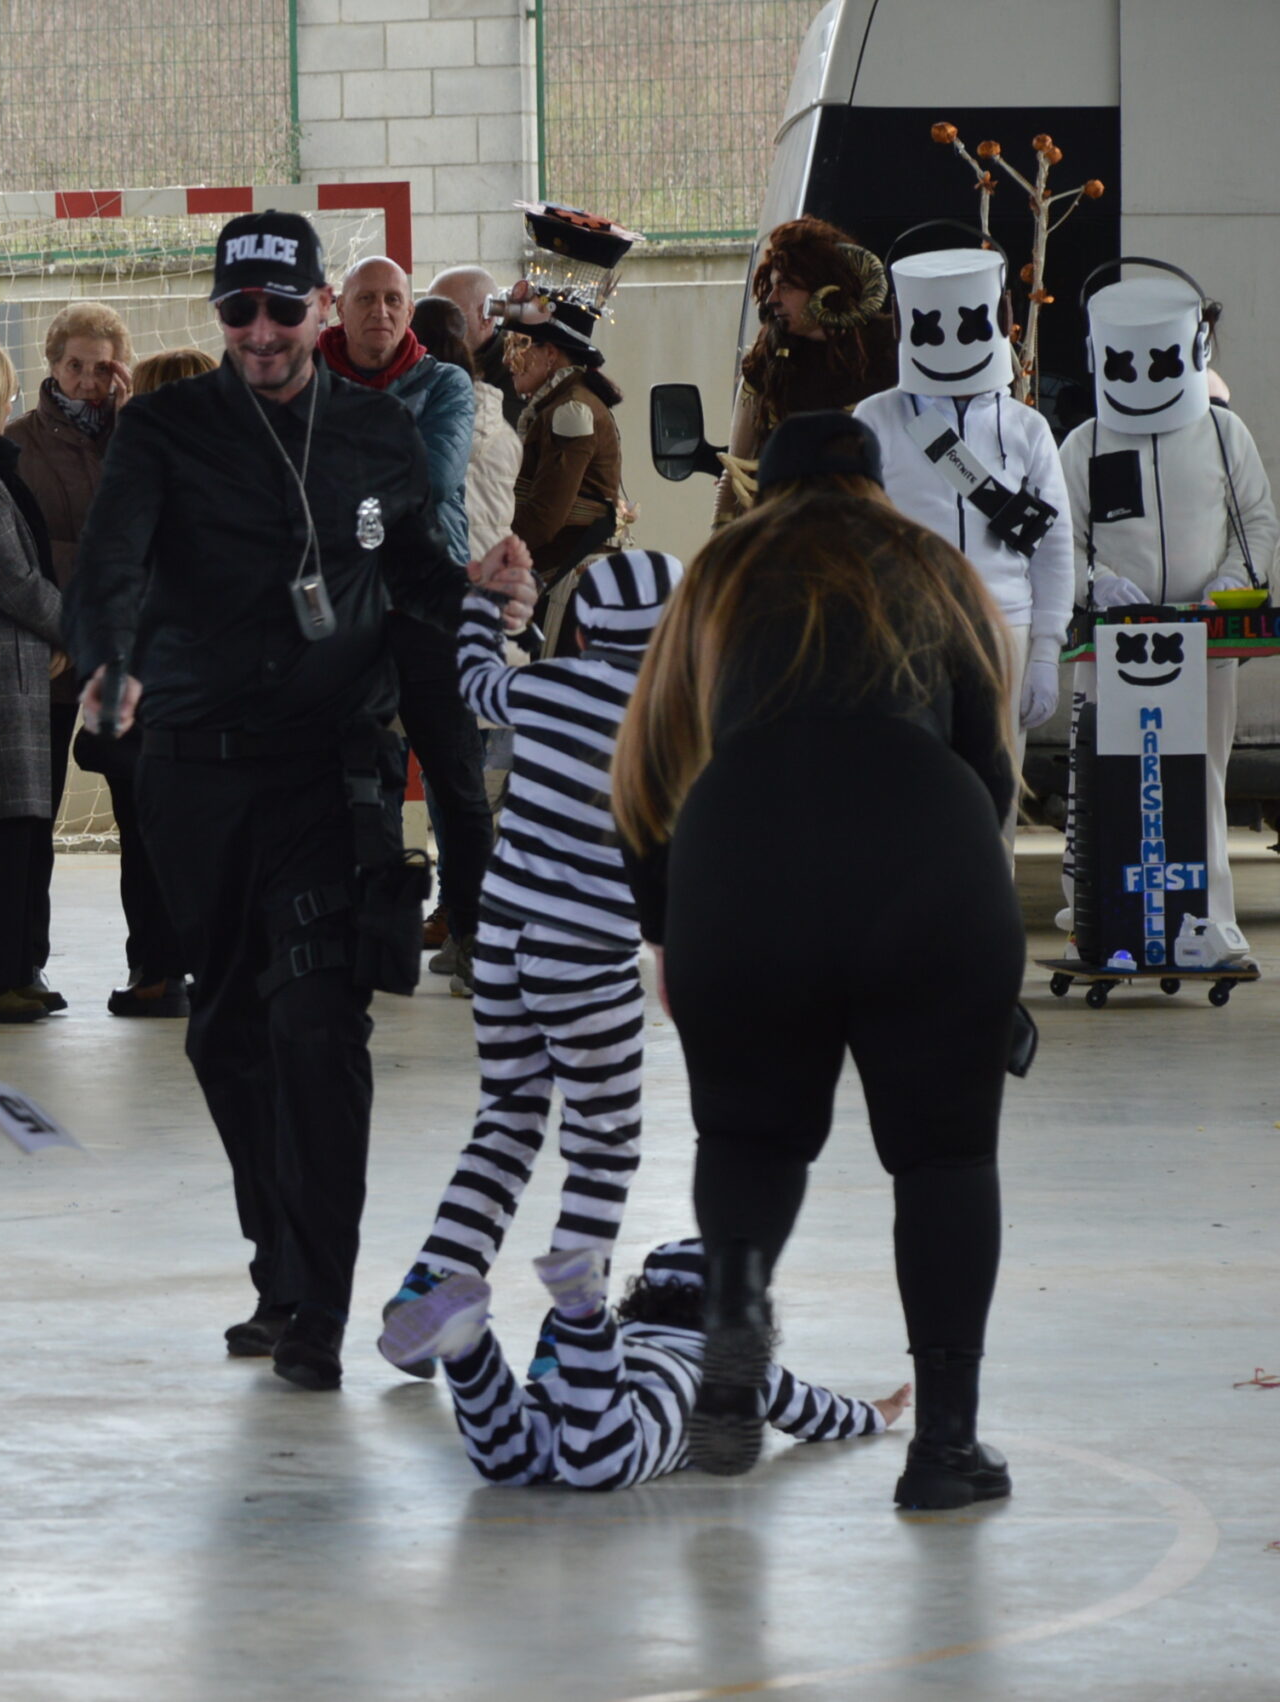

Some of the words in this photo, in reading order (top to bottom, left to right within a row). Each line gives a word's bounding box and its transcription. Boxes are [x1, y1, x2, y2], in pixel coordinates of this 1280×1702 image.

[225, 234, 298, 265] POLICE
[946, 449, 977, 484] FORTNITE
[1140, 707, 1165, 964] MARSHMELLO
[1126, 863, 1205, 891] FEST
